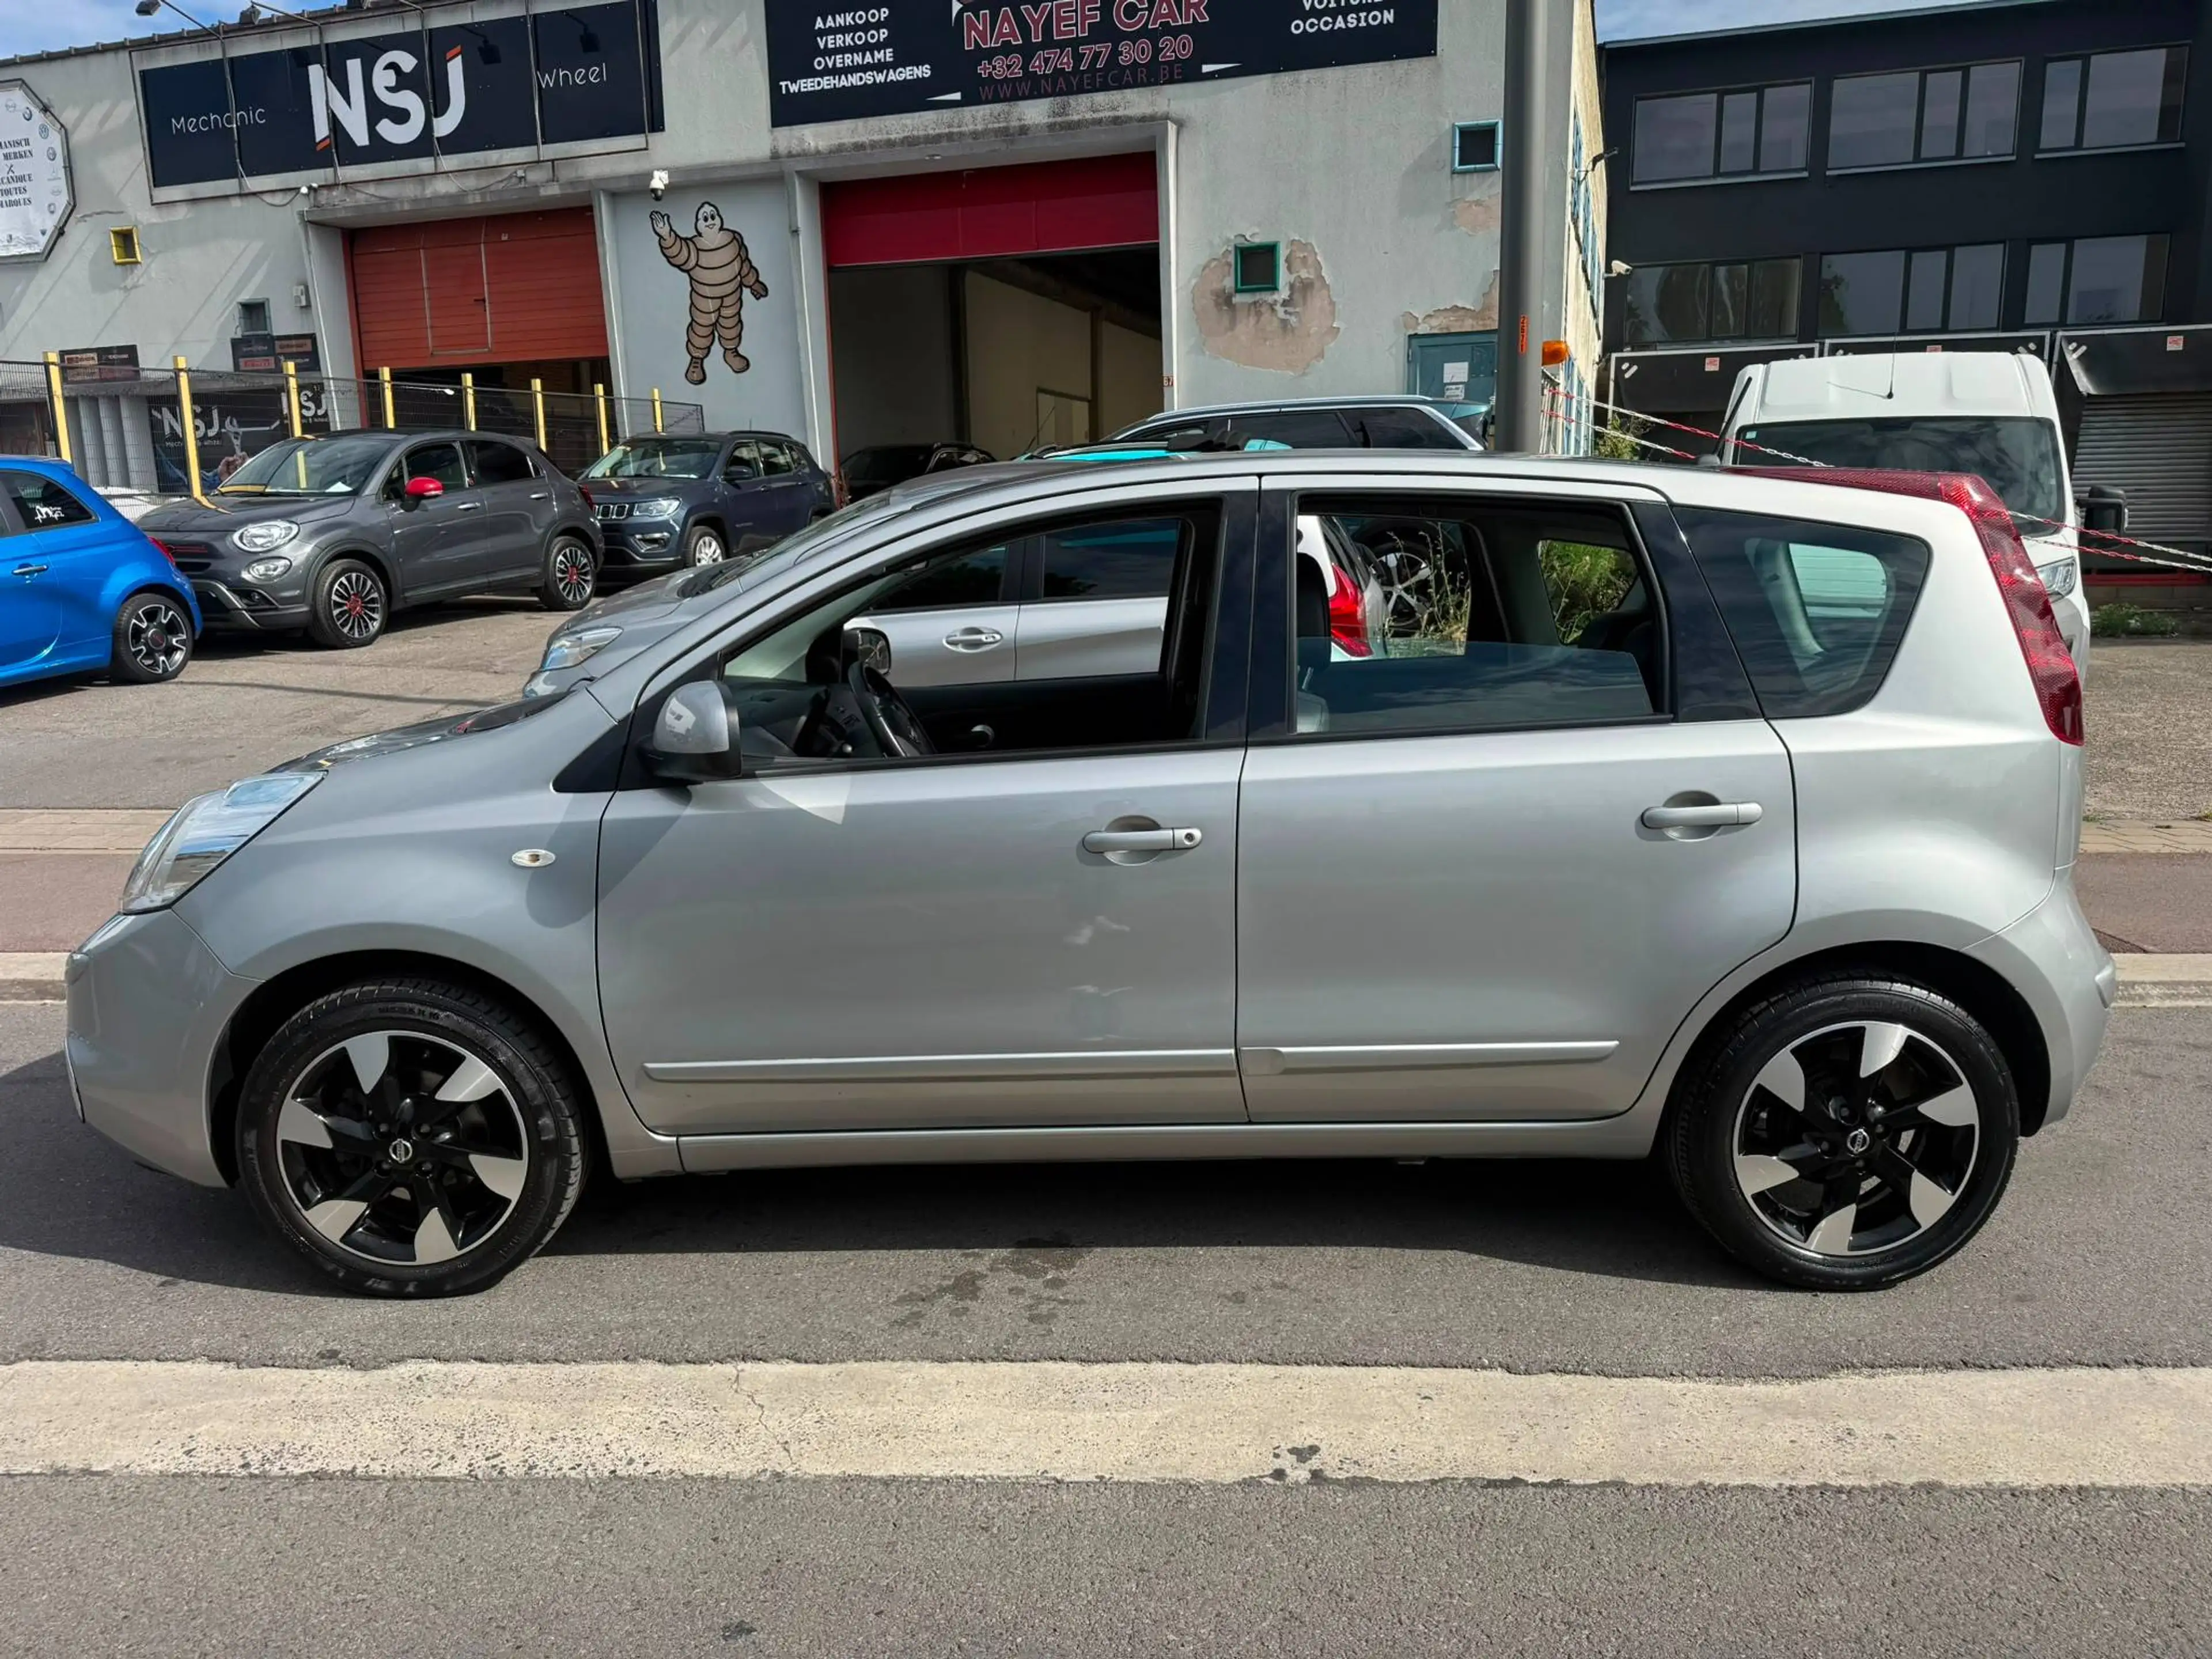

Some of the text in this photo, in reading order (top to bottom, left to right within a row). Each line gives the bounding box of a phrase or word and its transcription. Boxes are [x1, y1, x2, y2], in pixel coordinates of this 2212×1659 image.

[815, 7, 889, 29] AANKOOP
[964, 0, 1209, 50] NAYEF CAR
[1291, 9, 1394, 34] OCCASION
[817, 29, 888, 49] VERKOOP
[813, 48, 893, 70] OVERNAME
[978, 35, 1193, 79] +32 474 77 30 20
[779, 64, 931, 94] TWEEDEHANDSWAGENS
[979, 64, 1182, 100] WWW.NAYEFCAR.BE
[308, 45, 465, 150] NSJ
[171, 107, 266, 135] Mechanic
[2, 149, 33, 161] MERKEN
[0, 173, 33, 184] CANIQUE
[0, 186, 27, 196] TOUTES
